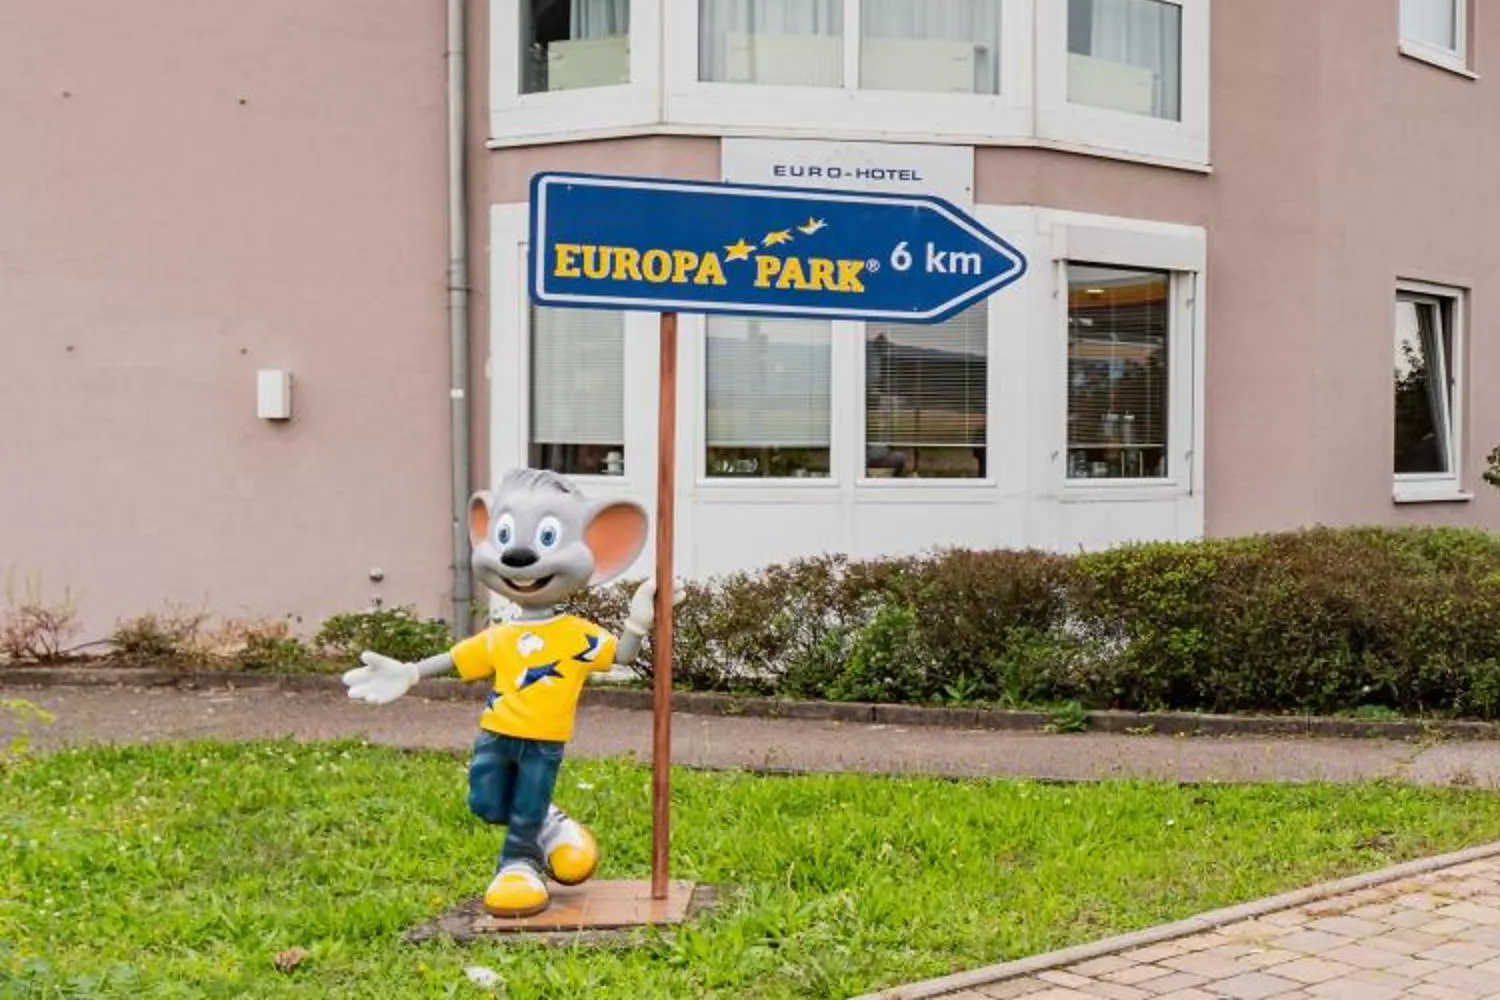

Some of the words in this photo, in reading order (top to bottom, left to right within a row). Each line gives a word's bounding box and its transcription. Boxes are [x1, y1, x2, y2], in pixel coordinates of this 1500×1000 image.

[773, 164, 924, 181] EURO-HOTEL
[553, 243, 727, 286] EUROPA
[890, 241, 913, 272] 6
[925, 242, 982, 275] km
